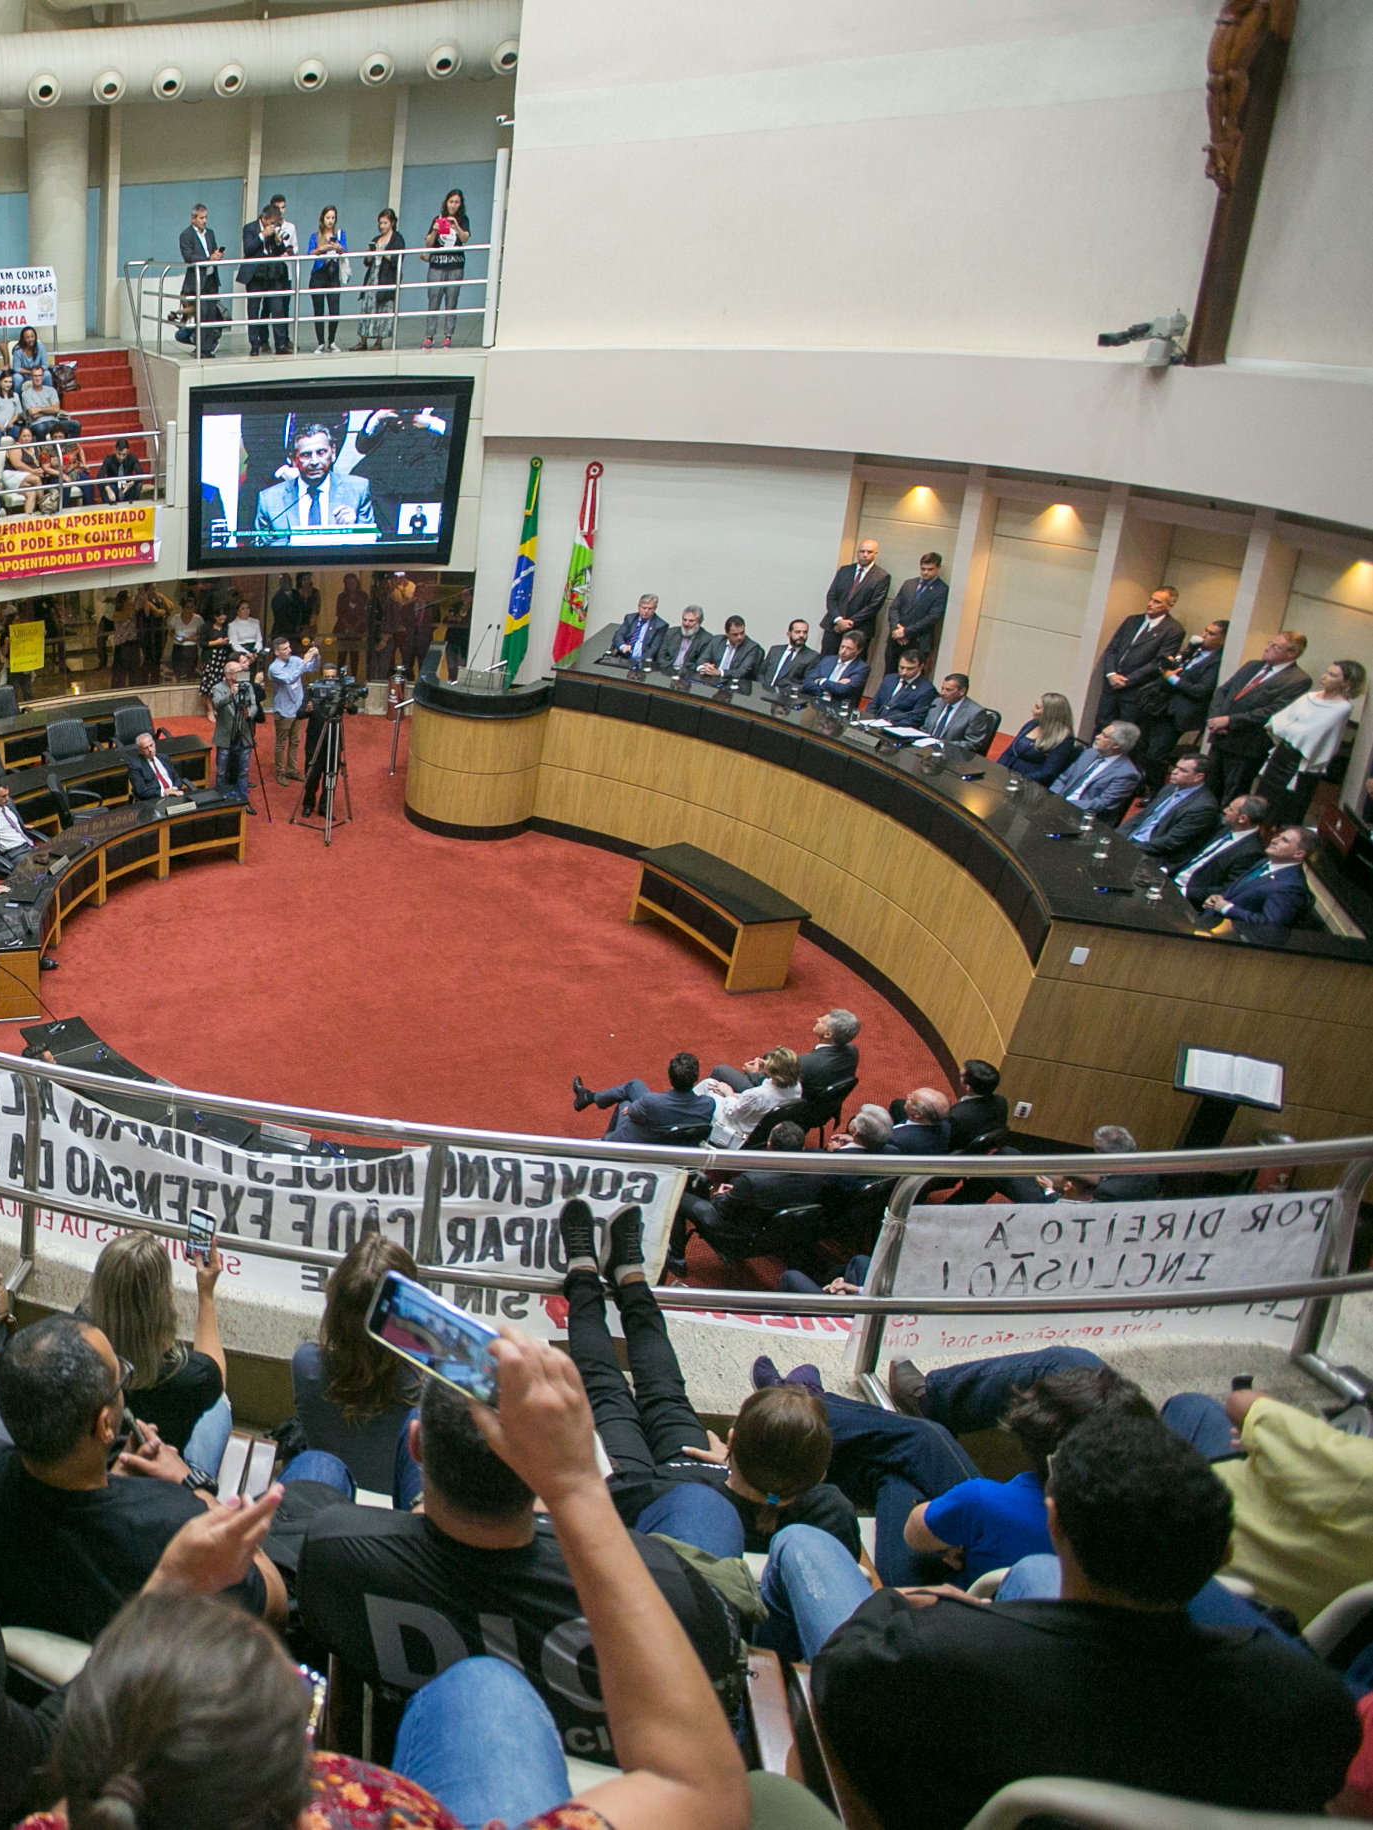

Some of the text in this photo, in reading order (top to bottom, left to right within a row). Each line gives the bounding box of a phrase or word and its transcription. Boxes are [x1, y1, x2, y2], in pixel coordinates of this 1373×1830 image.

[16, 269, 52, 280] CONTRA
[65, 510, 146, 528] APOSENTADO
[20, 535, 53, 551] PODE
[57, 532, 79, 547] SER
[84, 528, 134, 543] CONTRA
[86, 549, 101, 562] DO
[104, 546, 137, 561] POVO!
